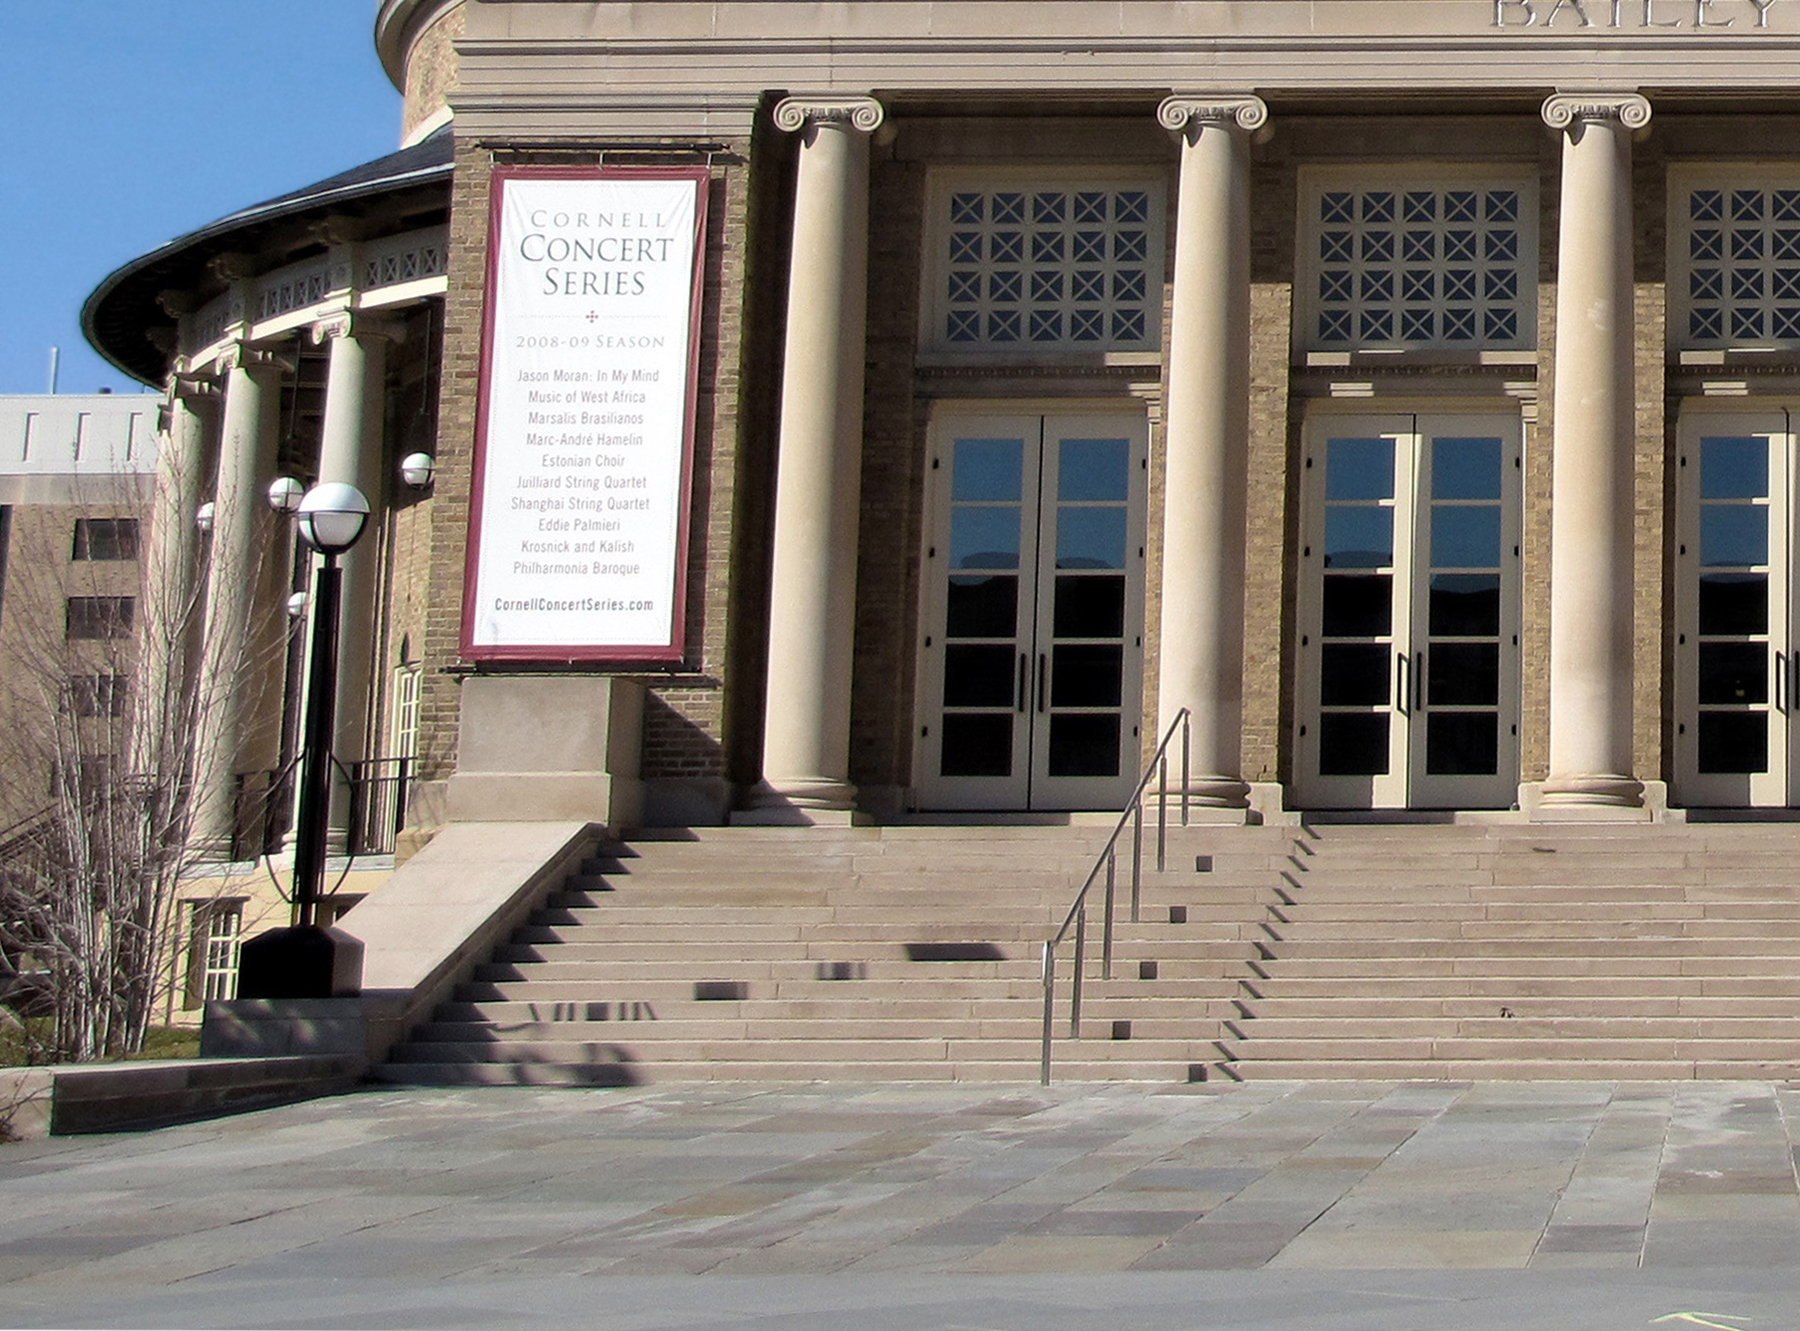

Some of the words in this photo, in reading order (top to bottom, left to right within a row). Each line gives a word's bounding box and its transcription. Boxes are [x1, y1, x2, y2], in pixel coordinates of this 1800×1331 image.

[530, 208, 667, 229] CORNELL
[519, 232, 675, 263] CONCERT
[542, 266, 646, 297] SERIES
[515, 335, 590, 349] 2008-09
[595, 334, 666, 349] SEASON
[517, 369, 550, 383] Jason
[552, 369, 593, 383] Moran:
[596, 369, 609, 382] In
[611, 369, 629, 385] My
[631, 369, 660, 383] Mind
[528, 390, 563, 404] Music
[565, 390, 578, 404] of
[580, 390, 609, 404] West
[611, 390, 647, 404] Africa
[527, 411, 578, 425] Marsalis
[580, 411, 645, 425] Brasilianos
[526, 432, 594, 446] Marc-André
[596, 433, 644, 446] Hamelin
[541, 454, 592, 468] Estonian
[594, 454, 626, 468] Choir
[516, 475, 562, 489] Juilliard
[564, 475, 601, 492] String
[603, 475, 648, 490] Quartet
[511, 496, 565, 513] Shanghai
[567, 496, 604, 513] String
[606, 497, 650, 511] Quartet
[538, 518, 571, 532] Eddie
[573, 518, 621, 532] Palmieri
[521, 539, 571, 554] Krosnick
[573, 540, 596, 554] and
[599, 539, 635, 554] Kalish
[513, 560, 589, 575] Philharmonia
[592, 560, 641, 577] Baroque
[494, 597, 654, 612] CornellConcertSeries.com
